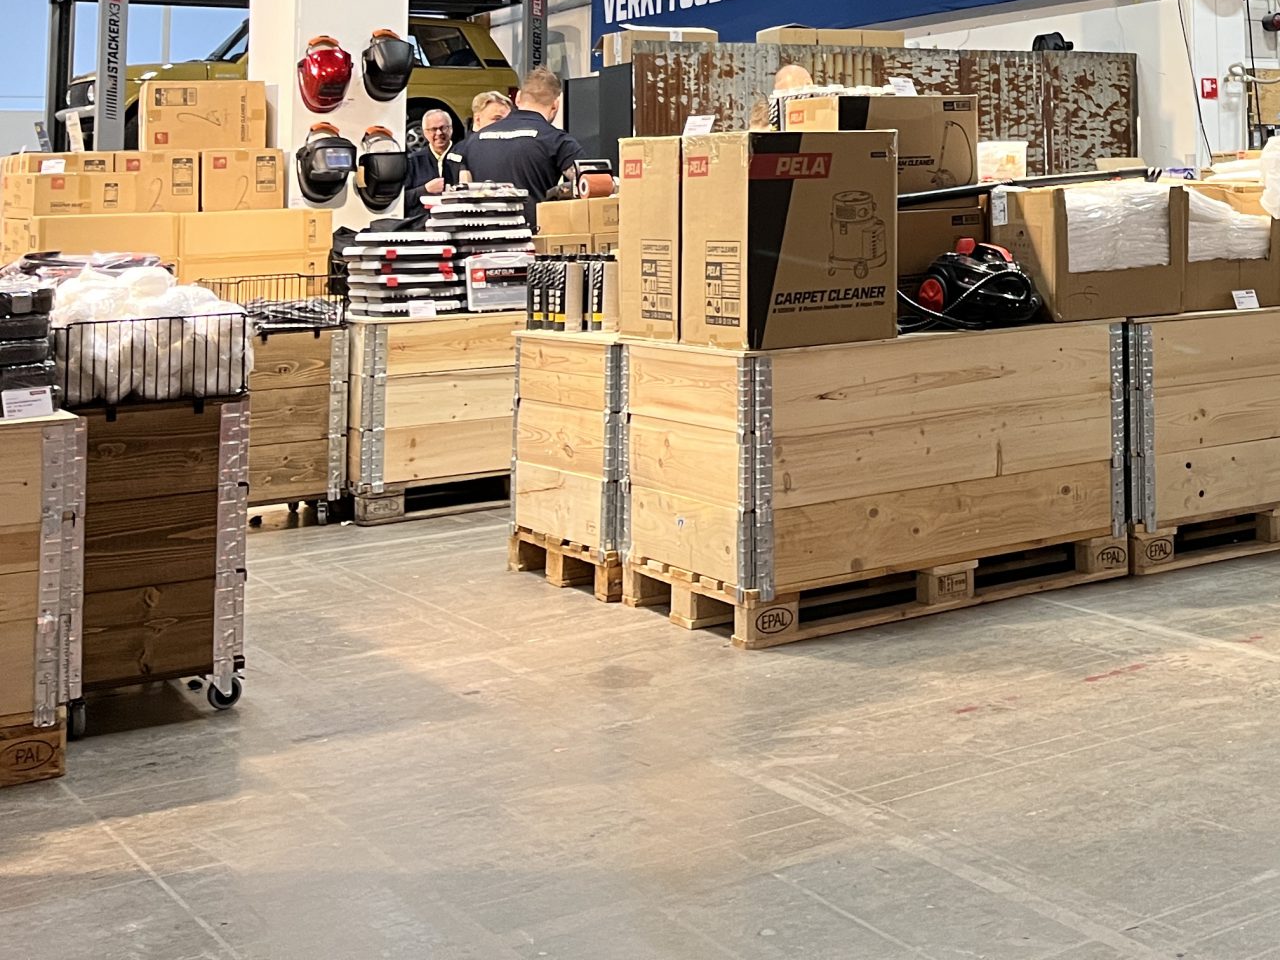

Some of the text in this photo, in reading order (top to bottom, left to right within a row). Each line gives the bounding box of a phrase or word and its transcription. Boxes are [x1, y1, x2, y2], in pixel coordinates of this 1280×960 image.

[624, 162, 641, 176] PELA
[689, 159, 707, 175] PELA
[775, 156, 826, 176] PELA
[907, 159, 935, 167] CLEANER
[774, 286, 886, 306] CARPET CLEANER
[1149, 542, 1168, 558] EPAL
[761, 611, 788, 631] EPAL
[10, 745, 45, 765] PAL
